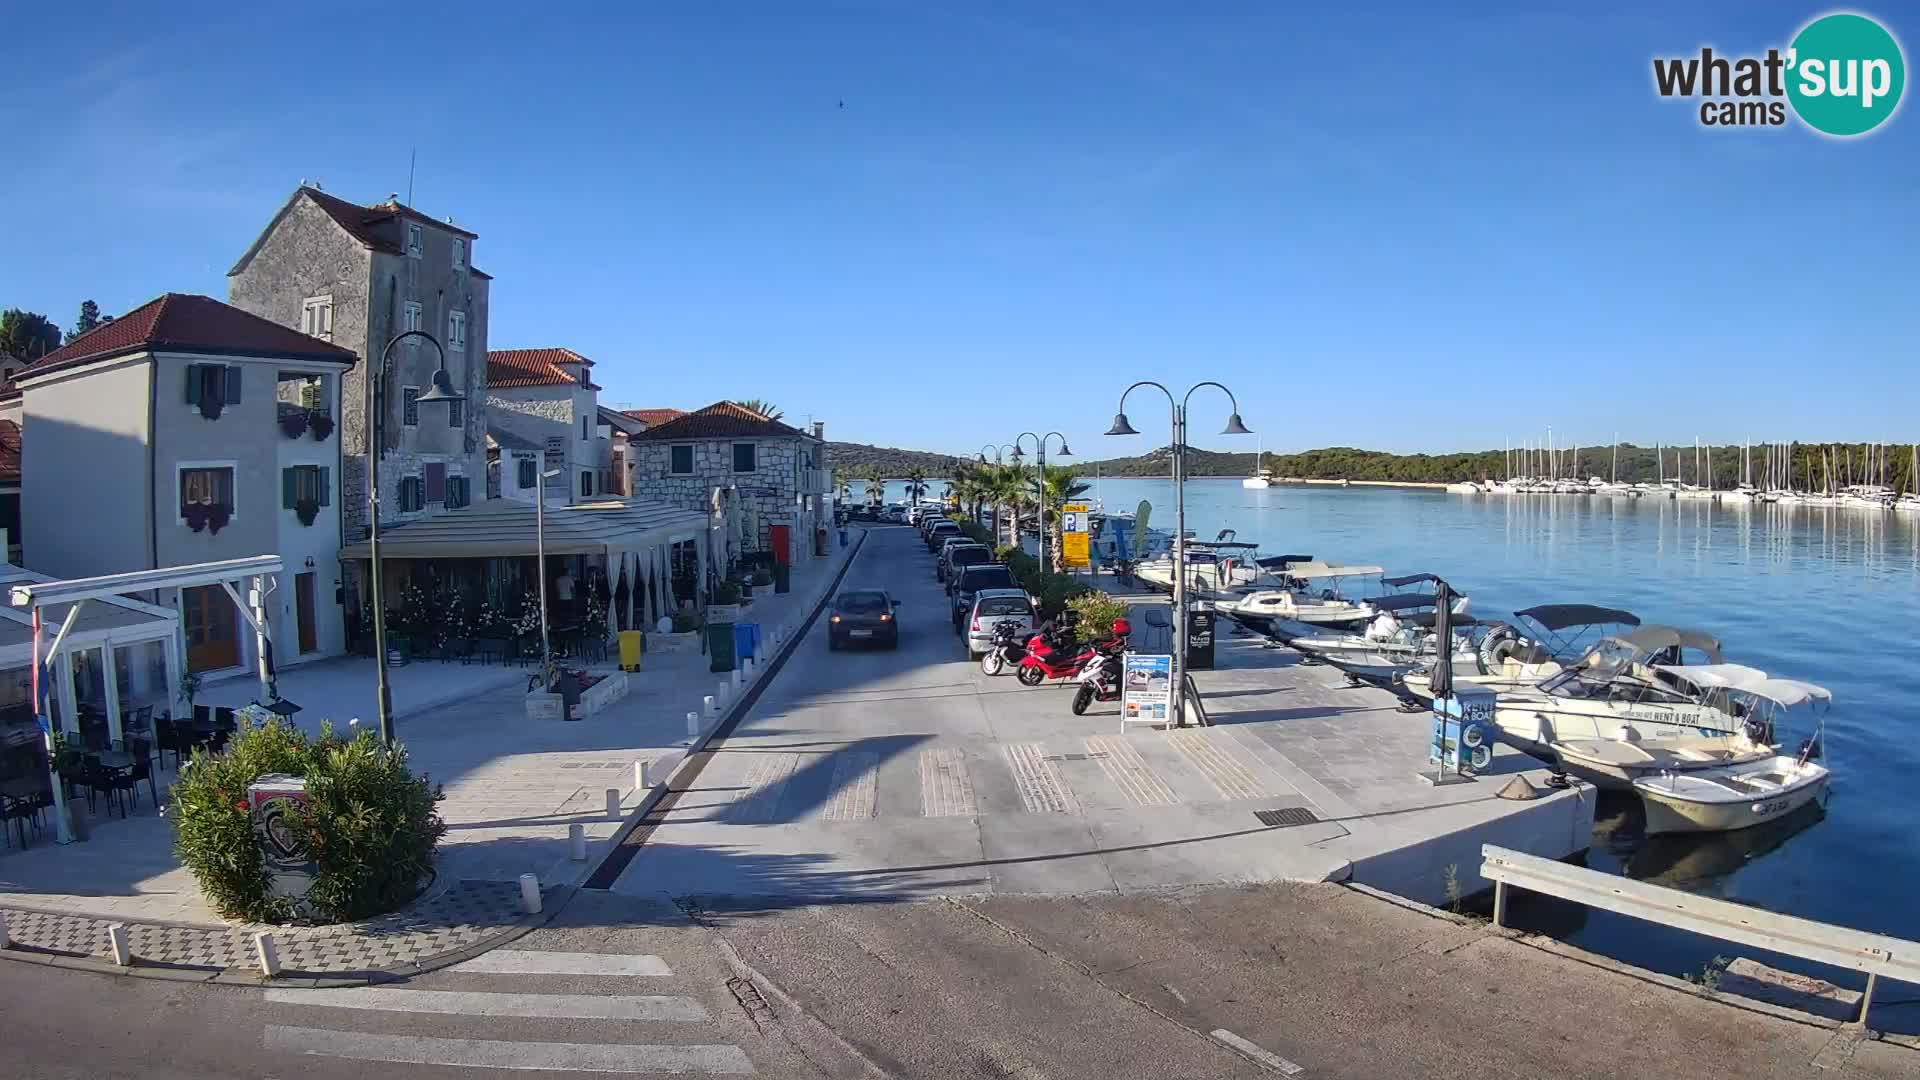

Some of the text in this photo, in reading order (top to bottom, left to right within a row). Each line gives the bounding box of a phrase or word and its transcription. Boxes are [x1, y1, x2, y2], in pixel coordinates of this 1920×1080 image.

[1463, 702, 1494, 712] RENT
[1463, 713, 1470, 721] A
[1654, 710, 1674, 723] RENT
[1681, 712, 1701, 725] BOAT
